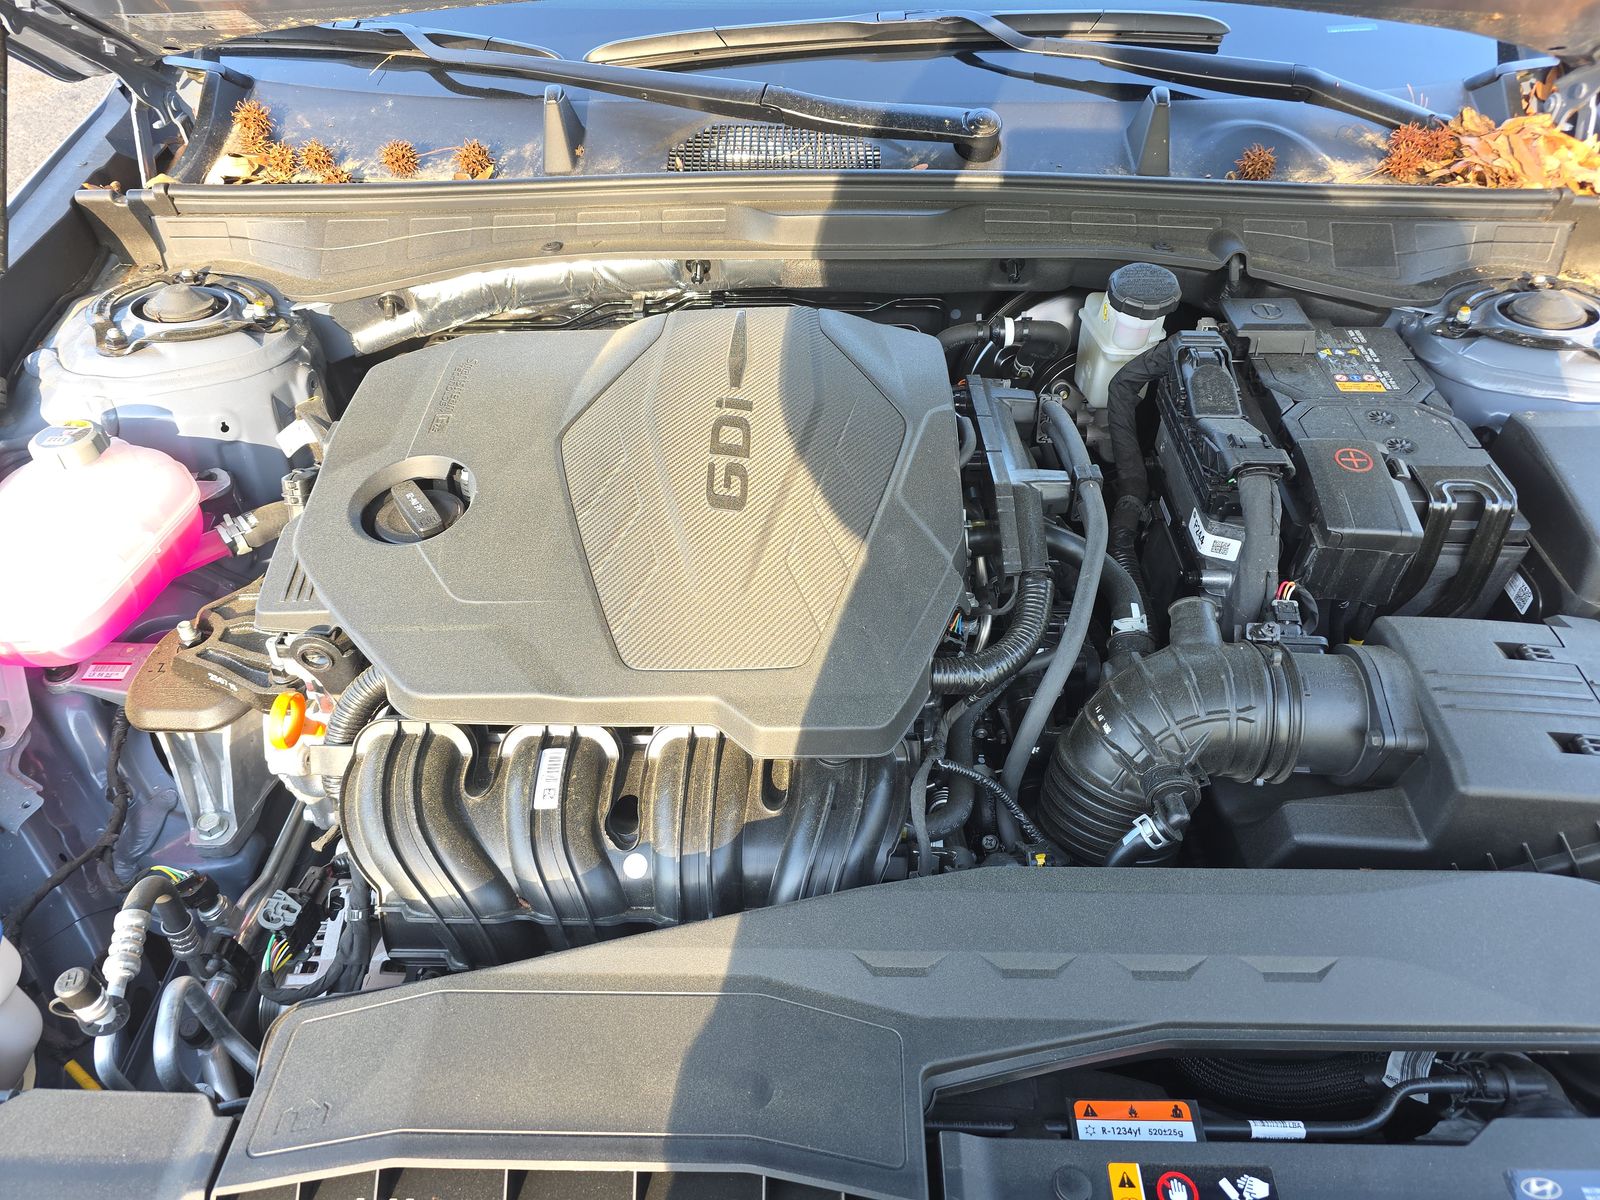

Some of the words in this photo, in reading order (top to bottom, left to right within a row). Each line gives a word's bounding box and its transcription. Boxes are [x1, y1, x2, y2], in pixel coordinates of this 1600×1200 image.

[706, 397, 753, 511] GDi
[1101, 1126, 1142, 1137] R-1234yf
[1148, 1128, 1184, 1138] 520±25g
